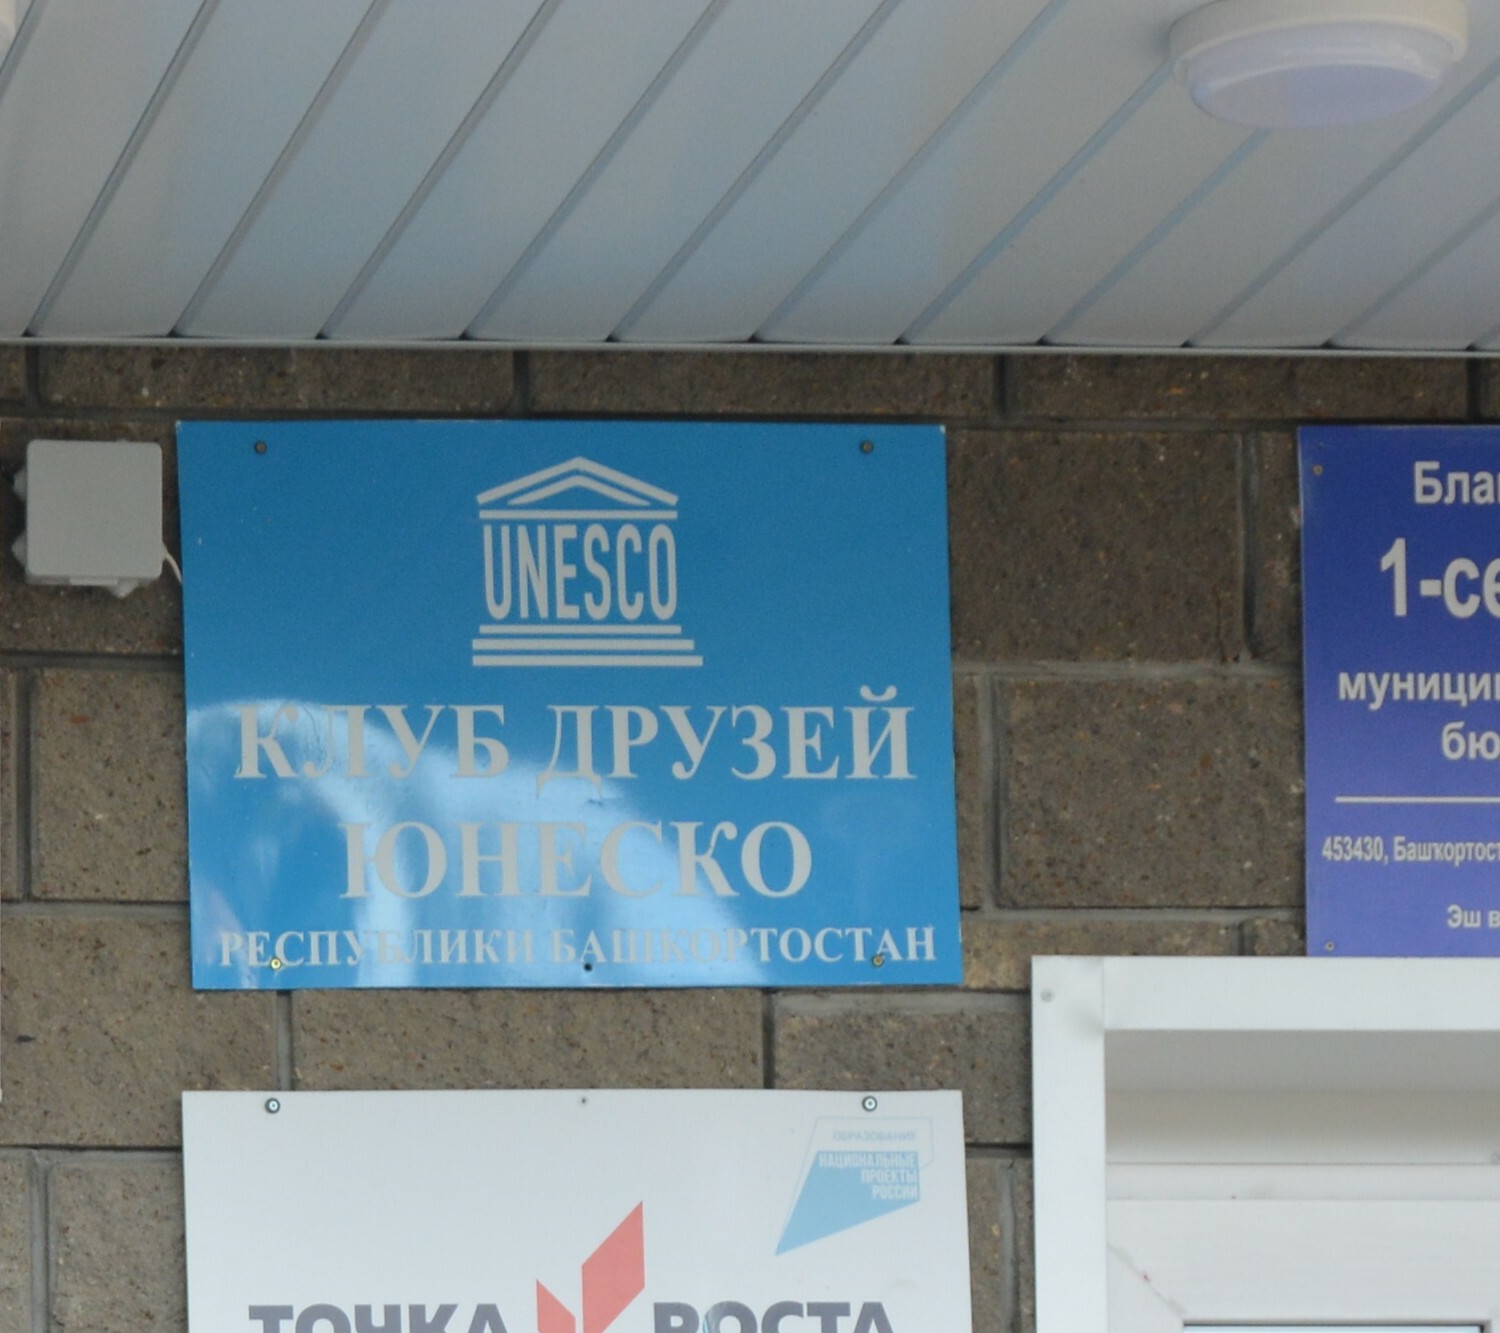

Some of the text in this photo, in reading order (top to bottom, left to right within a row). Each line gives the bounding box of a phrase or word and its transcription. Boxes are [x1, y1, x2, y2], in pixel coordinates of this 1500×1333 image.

[483, 523, 678, 621] UNESCO
[234, 685, 916, 794] КЛУБ ДРУЗЕЙ
[338, 821, 813, 900] ЮНЕСКО
[1322, 837, 1388, 865] 453430,
[1447, 905, 1481, 928] Эш
[220, 926, 935, 967] РЕСПУБЛИКИ БАШКОРТОСТАН
[819, 1152, 916, 1168] НАЦИОНАЛЬНЫЕ
[861, 1169, 918, 1184] ПРОЕКТЫ
[872, 1185, 918, 1199] РОССИИ
